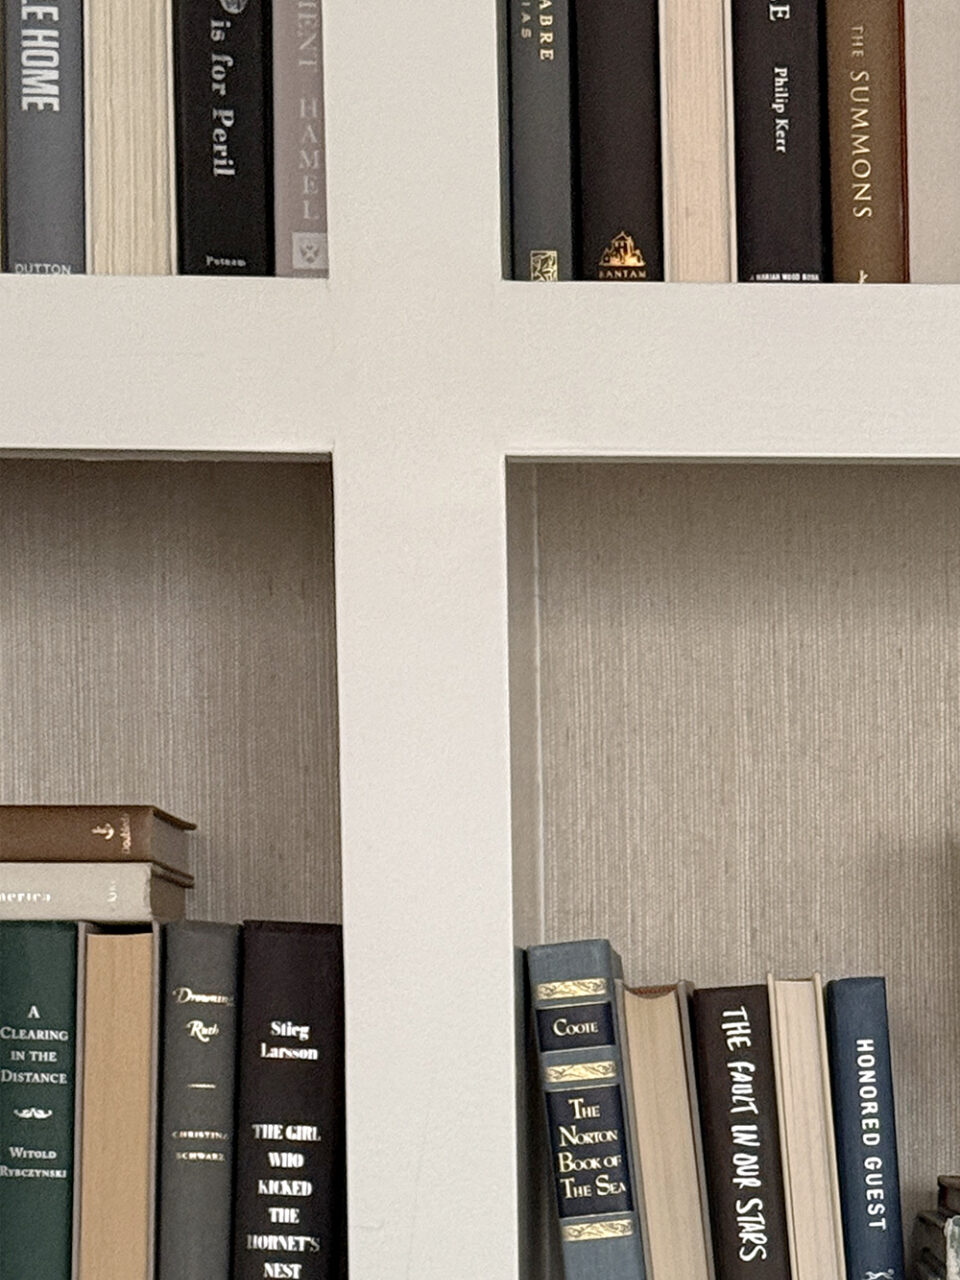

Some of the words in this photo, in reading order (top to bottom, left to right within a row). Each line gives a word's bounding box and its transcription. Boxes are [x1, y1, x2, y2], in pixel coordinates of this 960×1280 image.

[21, 0, 59, 20] E
[768, 0, 791, 21] E
[211, 20, 231, 41] is
[850, 25, 864, 58] THE
[21, 29, 59, 111] HOME
[211, 54, 234, 96] for
[771, 67, 789, 114] Philip
[212, 108, 236, 177] Peril
[774, 118, 790, 153] Kerr
[849, 70, 872, 218] SUMMONS
[15, 263, 72, 275] DUTTON
[27, 1005, 40, 1019] A
[0, 1026, 69, 1041] CLEARING
[271, 1021, 310, 1041] Stieg
[553, 1018, 598, 1036] COOTE
[721, 1006, 752, 1051] THE
[11, 1051, 25, 1061] IN
[29, 1051, 58, 1062] THE
[260, 1042, 318, 1060] Larsson
[1, 1070, 68, 1085] DISTANCE
[727, 1060, 759, 1114] FAULT
[856, 1038, 881, 1146] HONORED
[252, 1124, 283, 1140] THE
[285, 1125, 321, 1142] GIRL
[559, 1126, 618, 1146] NORTON
[731, 1124, 760, 1147] IN
[9, 1147, 57, 1159] WITOLD
[268, 1152, 304, 1168] WHO
[558, 1151, 601, 1173] BOOK
[732, 1152, 762, 1189] OUR
[258, 1179, 313, 1196] KICKED
[864, 1156, 888, 1231] GUEST
[268, 1207, 300, 1223] THE
[736, 1198, 768, 1262] STARS
[263, 1262, 302, 1279] NEST
